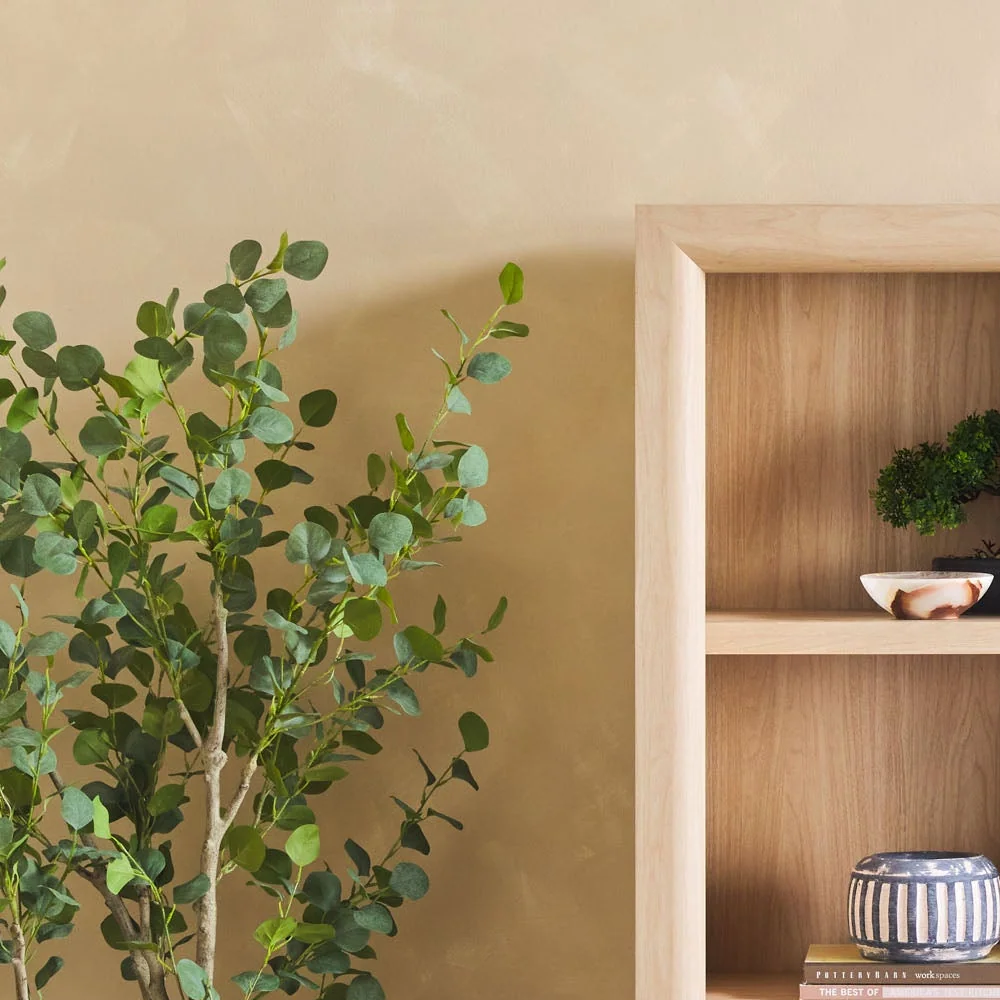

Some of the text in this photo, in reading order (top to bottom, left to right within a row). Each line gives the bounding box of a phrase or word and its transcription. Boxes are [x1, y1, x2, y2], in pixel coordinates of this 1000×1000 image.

[820, 988, 837, 997] THE
[841, 988, 864, 997] BEST
[867, 988, 879, 997] OF
